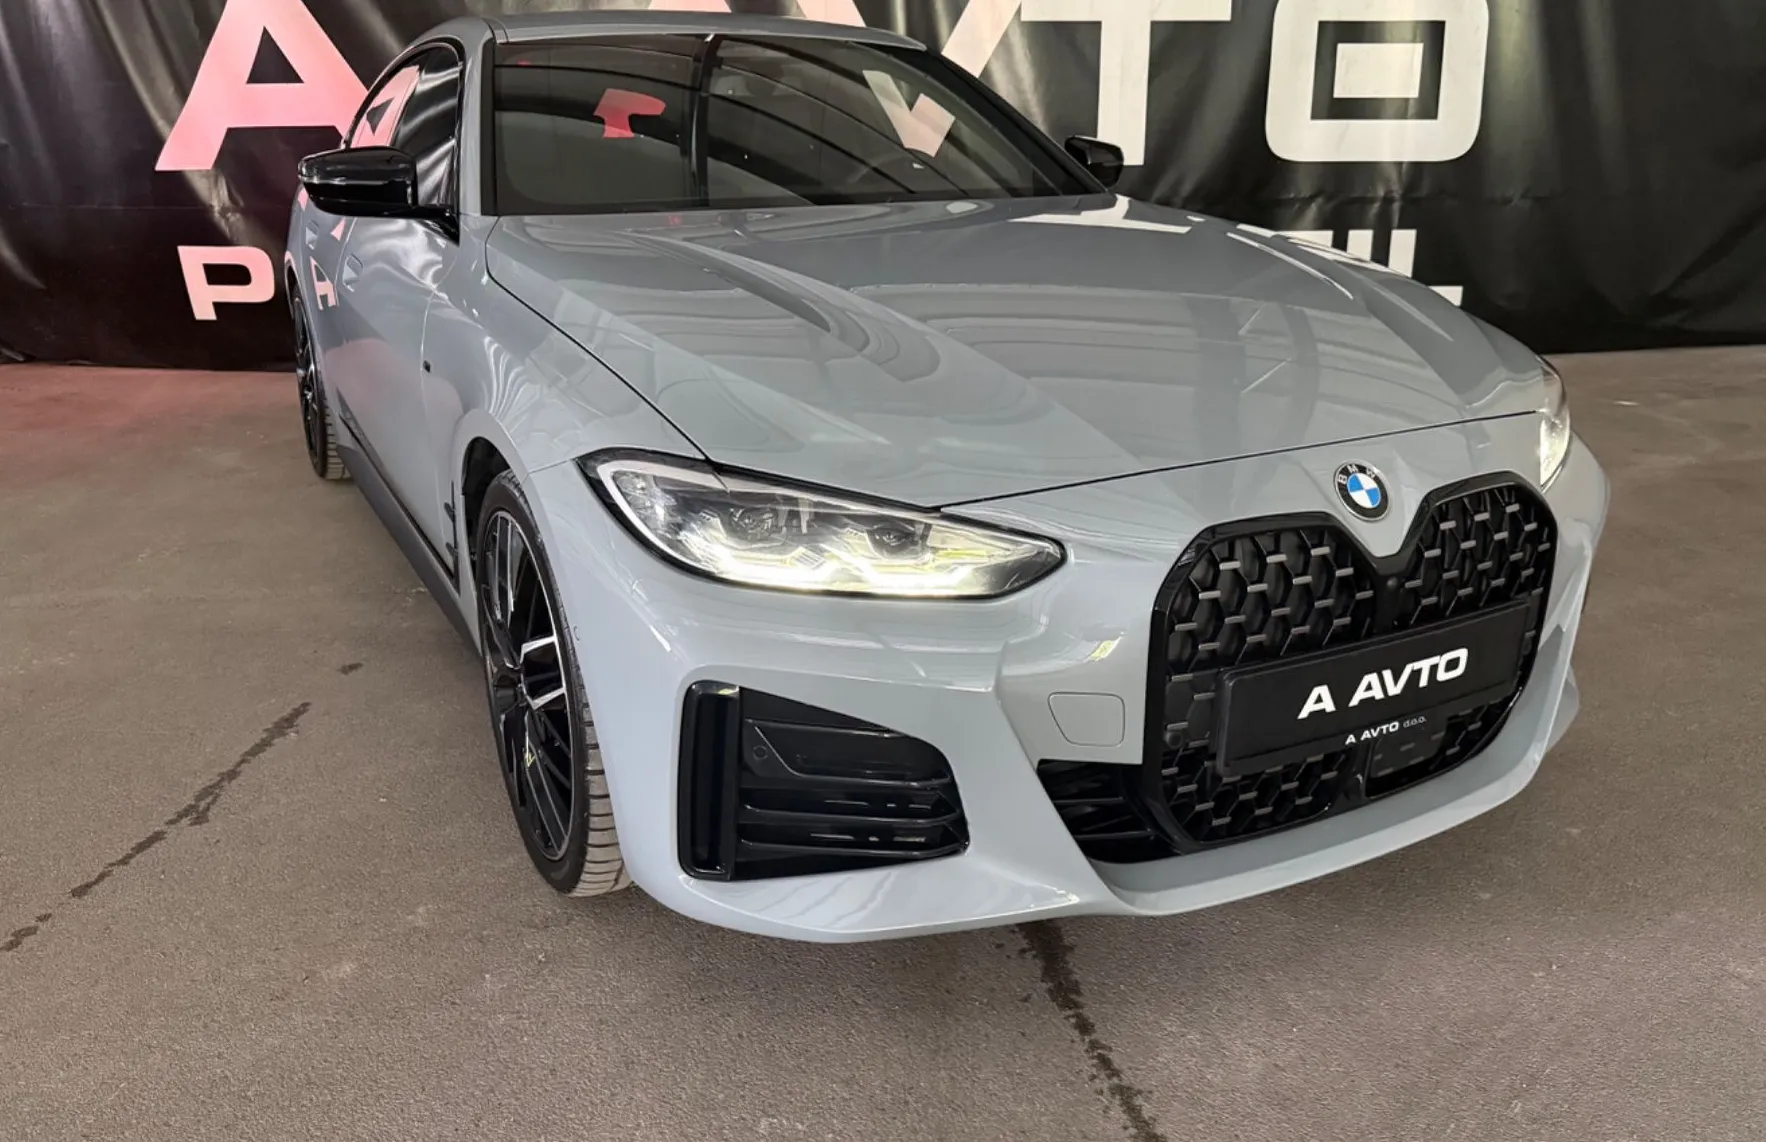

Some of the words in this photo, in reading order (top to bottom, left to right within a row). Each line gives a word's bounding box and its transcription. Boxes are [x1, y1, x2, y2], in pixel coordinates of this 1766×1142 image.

[155, 0, 371, 171] A
[1338, 464, 1376, 485] BMW
[1298, 684, 1336, 720] A
[1348, 648, 1469, 708] AVTO
[1345, 734, 1357, 746] A
[1360, 721, 1400, 741] AVTO
